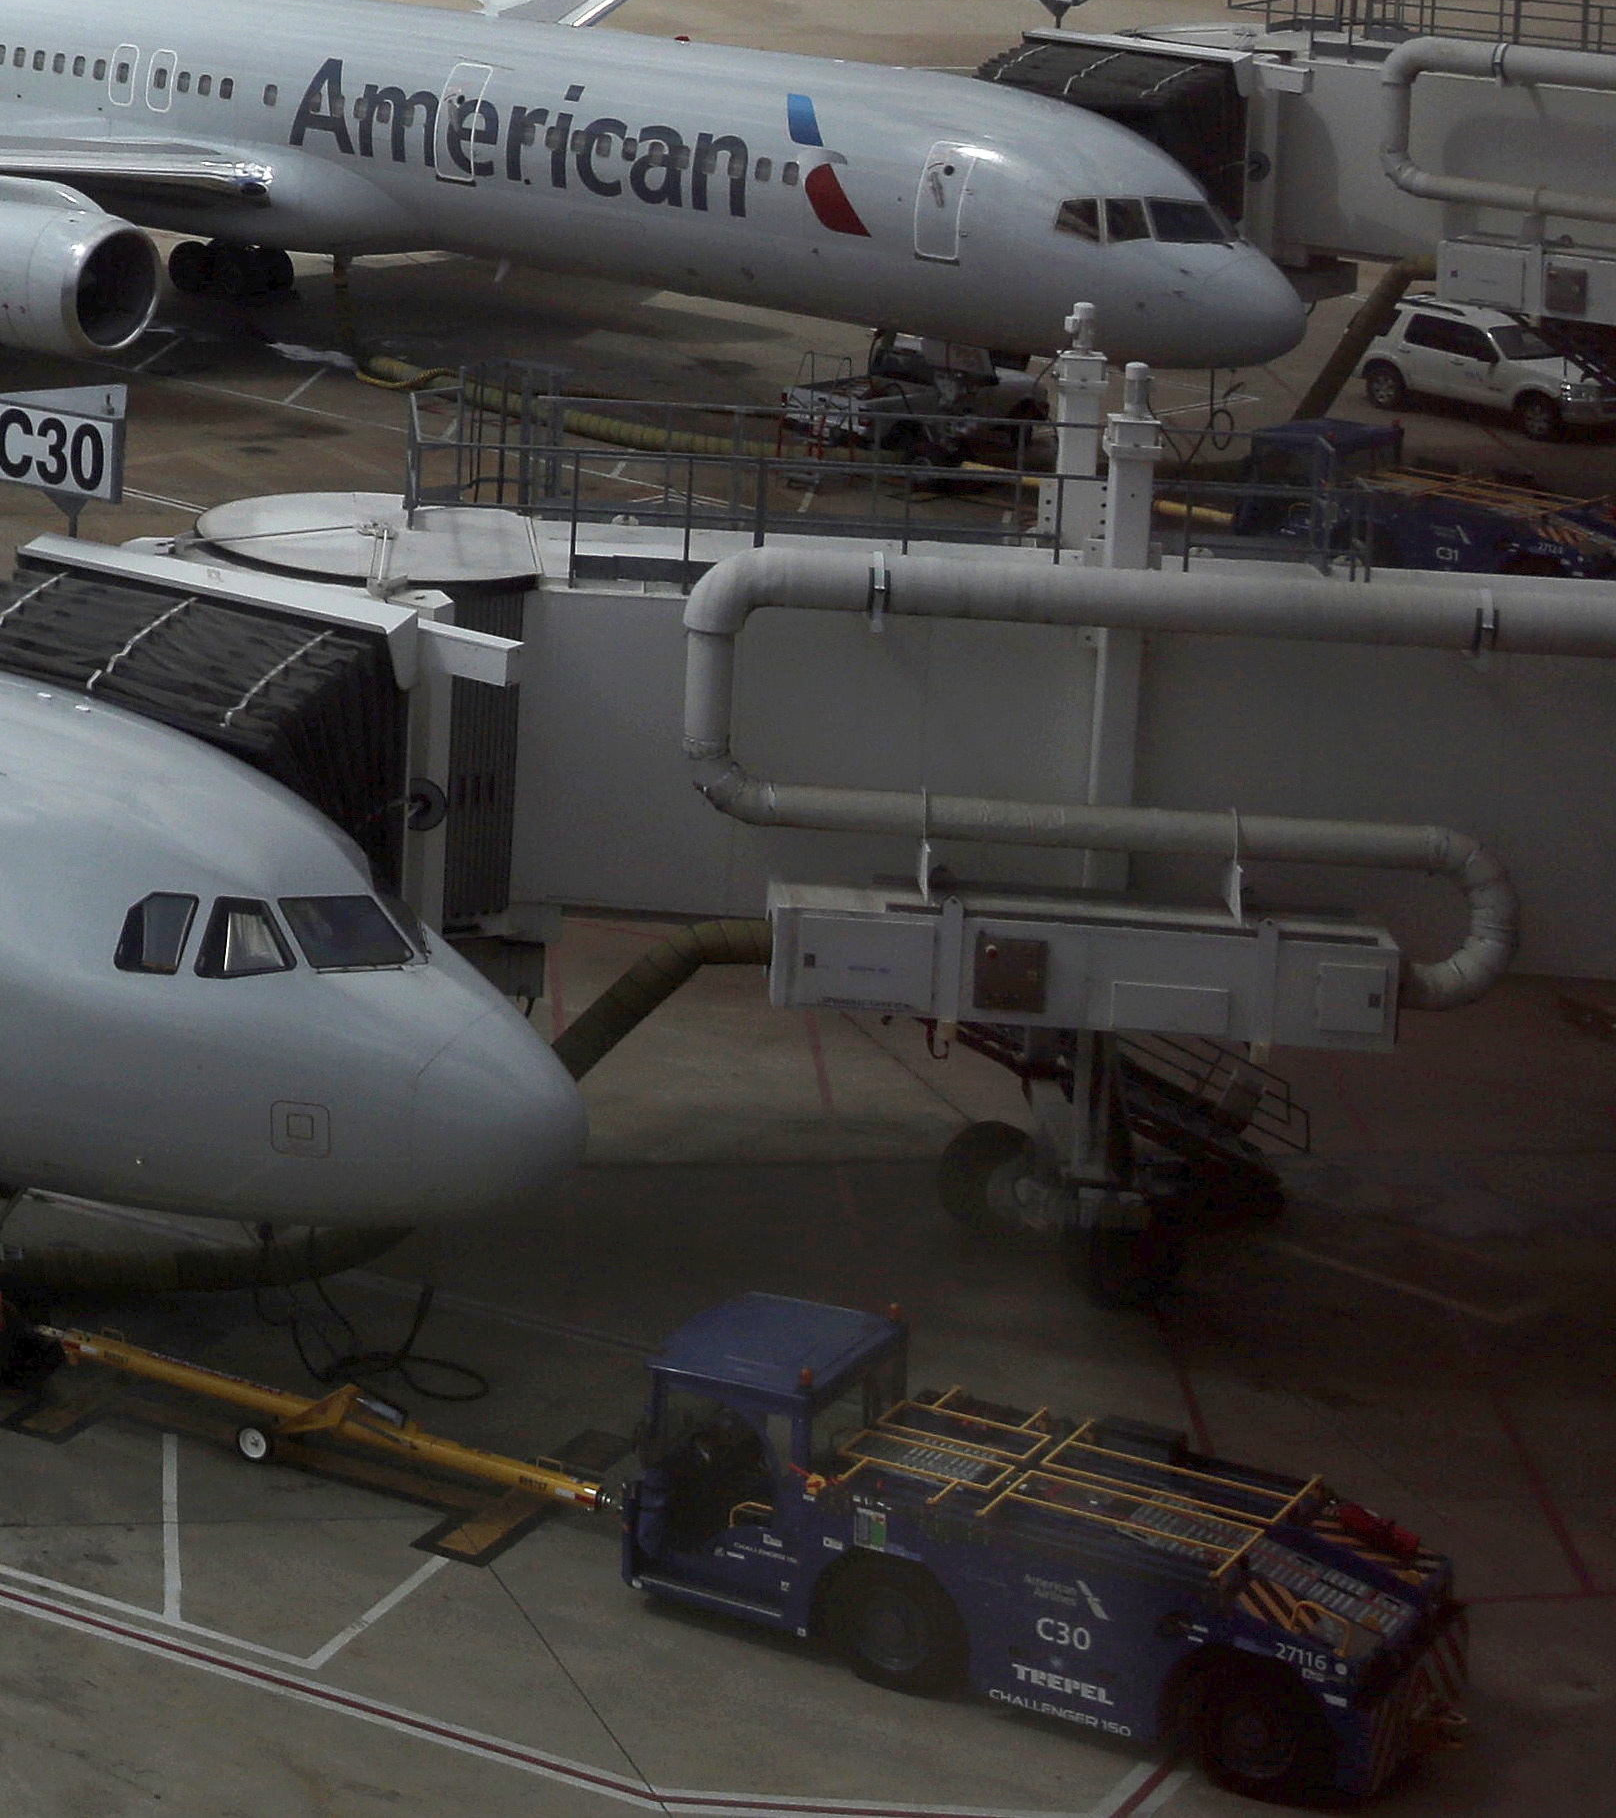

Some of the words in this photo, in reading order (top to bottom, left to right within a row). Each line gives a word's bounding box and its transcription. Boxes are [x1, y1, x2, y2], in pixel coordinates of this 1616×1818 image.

[290, 58, 748, 216] American
[1436, 546, 1458, 561] C31
[1036, 1617, 1091, 1651] C30
[1275, 1642, 1327, 1671] 27116
[1011, 1663, 1114, 1706] TREPEL
[988, 1688, 1099, 1728] CHALLENGER
[1101, 1719, 1132, 1737] 150
